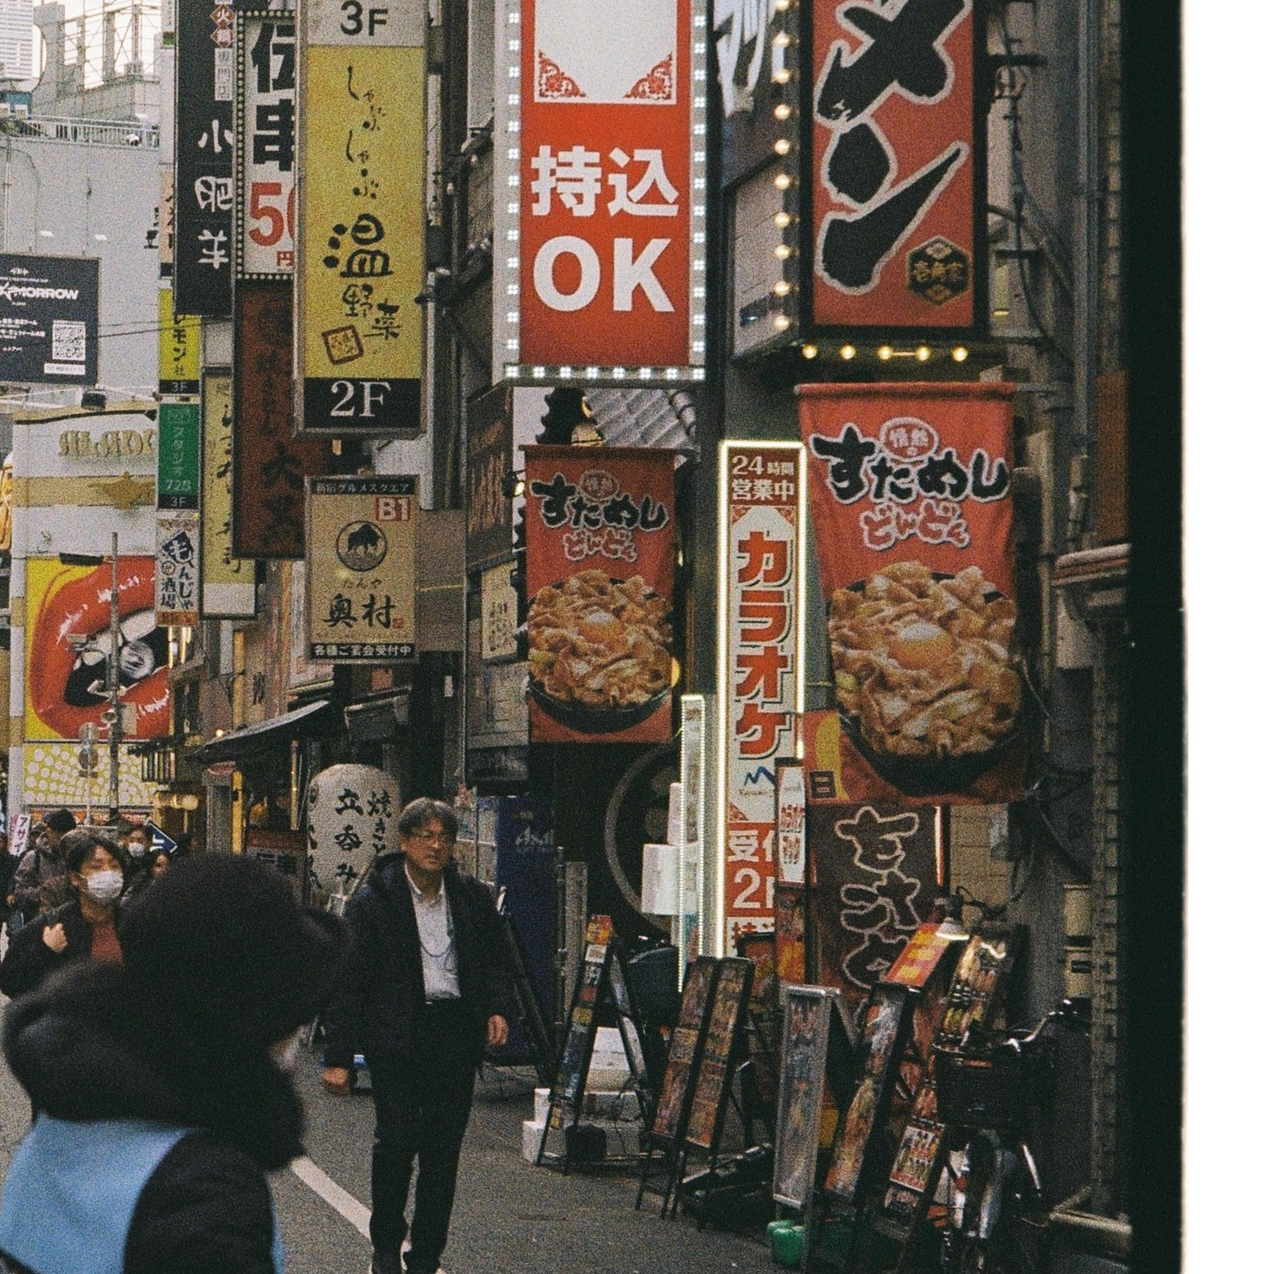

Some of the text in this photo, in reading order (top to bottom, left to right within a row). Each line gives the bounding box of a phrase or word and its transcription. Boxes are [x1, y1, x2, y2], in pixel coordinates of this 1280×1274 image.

[339, 1, 389, 38] 3F
[194, 118, 235, 269] 小肥羊
[248, 181, 296, 247] 5
[529, 144, 681, 219] 持込
[322, 212, 404, 340] 温野菜
[532, 235, 676, 314] OK
[329, 381, 392, 419] 2F
[730, 478, 796, 502] 営業中
[731, 455, 795, 477] 24時間
[809, 422, 1011, 505] すためし
[377, 497, 410, 521] B1
[529, 472, 670, 533] すためし
[170, 532, 194, 610] もんじゃ
[323, 592, 396, 629] 奥村
[734, 529, 794, 761] カラオケ
